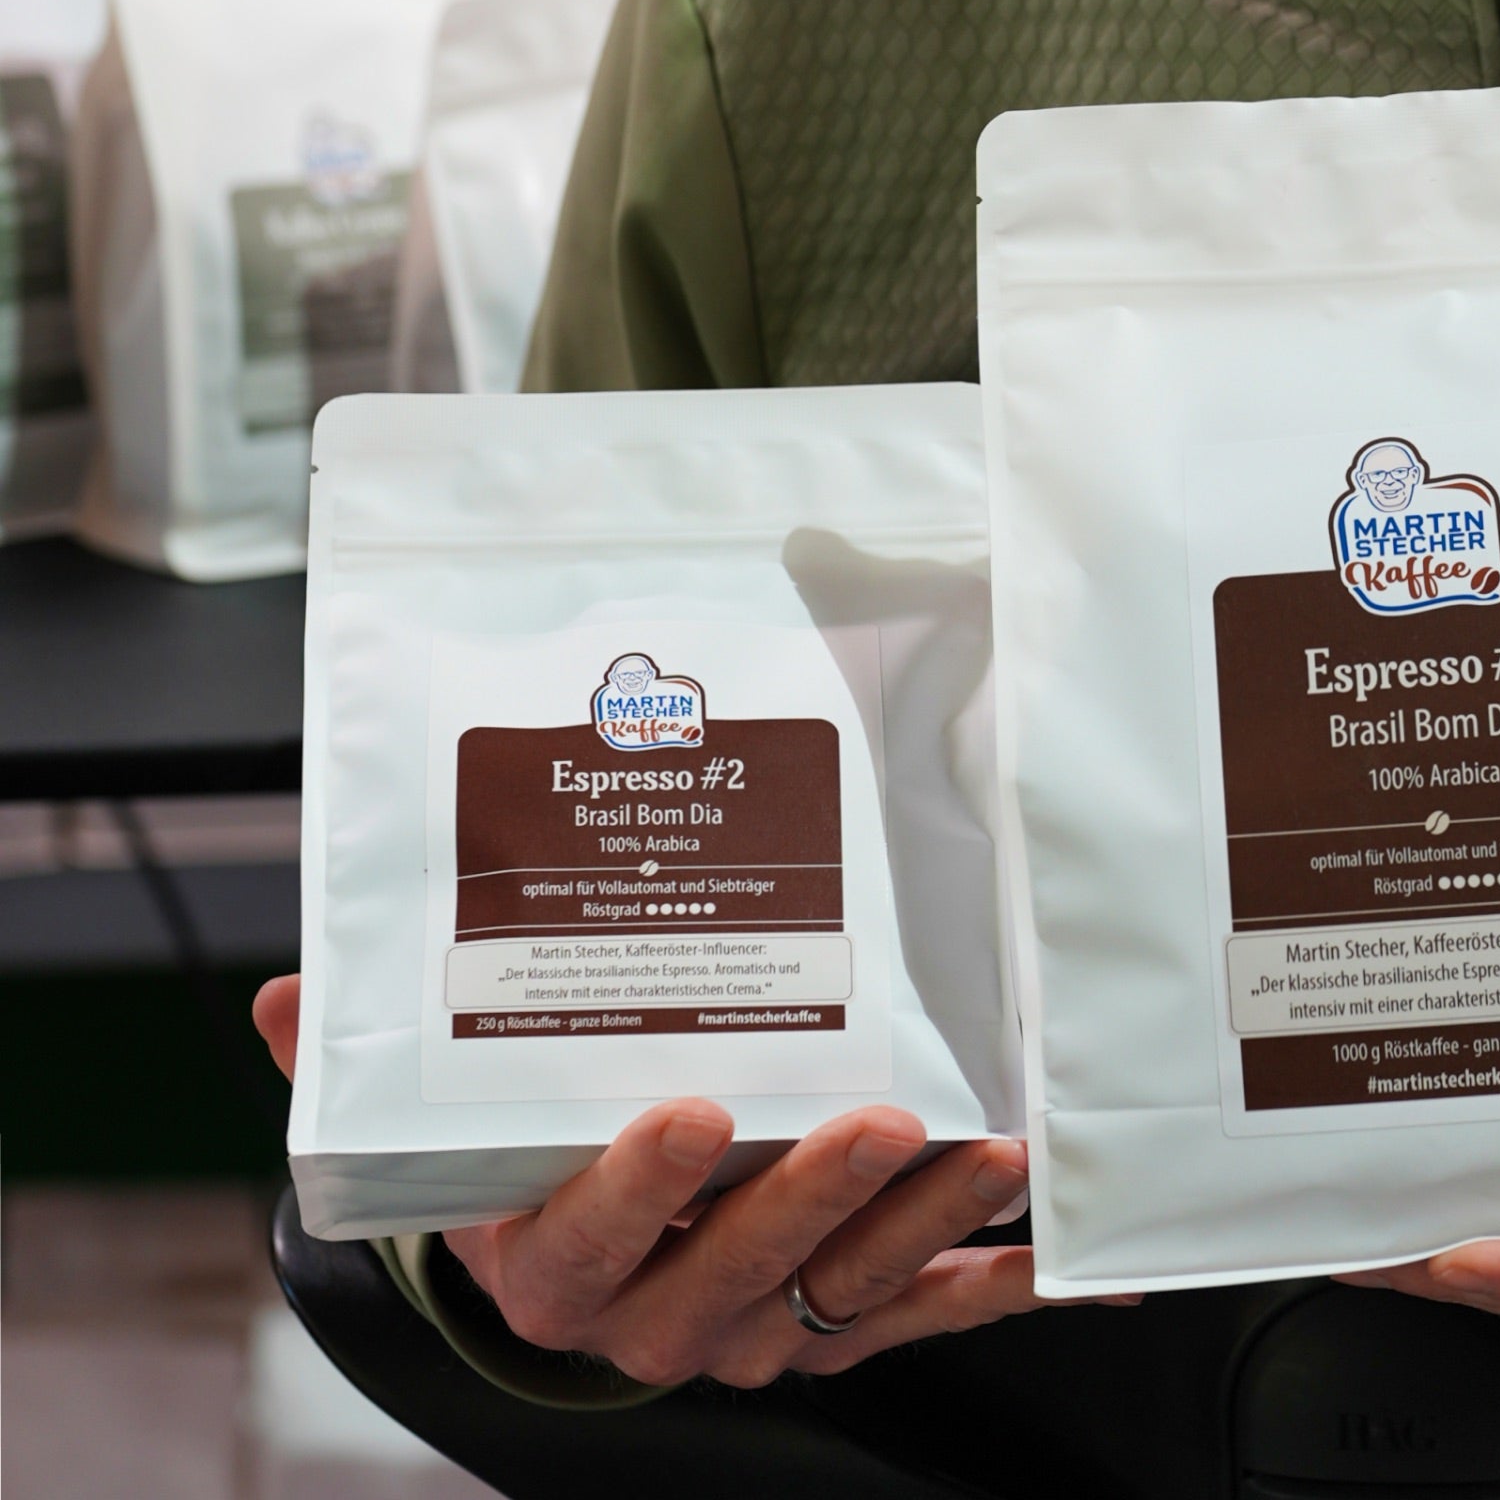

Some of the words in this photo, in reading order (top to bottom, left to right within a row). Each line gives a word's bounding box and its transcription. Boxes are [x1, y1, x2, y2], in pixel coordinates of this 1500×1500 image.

[1353, 510, 1484, 539] MARTIN
[1356, 531, 1485, 557] STECHER
[1345, 555, 1471, 599] Kaffee
[1305, 648, 1484, 702] Espresso
[607, 696, 692, 709] MARTIN
[607, 706, 692, 719] STECHER
[600, 719, 682, 742] Kaffee
[1330, 710, 1405, 747] Brasil
[1416, 706, 1478, 741] Bom
[551, 760, 693, 799] Espresso
[701, 757, 745, 790] #2
[1369, 766, 1424, 792] 100%
[1430, 762, 1500, 788] Arabica
[575, 804, 631, 826] Brasil
[638, 805, 684, 825] Bom
[690, 803, 723, 824] Dia
[598, 837, 641, 853] 100%
[645, 835, 700, 852] Arabica
[1310, 850, 1362, 872] optimal
[1365, 848, 1384, 867] für
[1387, 843, 1468, 865] Vollautomat
[1471, 841, 1497, 859] und
[522, 881, 573, 899] optimal
[576, 880, 595, 895] für
[597, 879, 676, 895] Vollautomat
[679, 879, 705, 894] und
[708, 878, 775, 896] Siebträger
[1373, 875, 1433, 897] Röstgrad
[583, 901, 641, 920] Röstgrad
[531, 946, 572, 959] Martin
[575, 945, 622, 959] Stecher,
[625, 943, 767, 957] Kaffeeröster-Influencer:
[1286, 944, 1340, 964] Martin
[1345, 937, 1409, 959] Stecher,
[528, 966, 582, 979] klassische
[585, 964, 660, 978] brasilianische
[662, 964, 711, 979] Espresso.
[714, 962, 776, 975] Aromatisch
[779, 962, 800, 975] und
[1251, 975, 1285, 996] „Der
[1288, 970, 1358, 991] klassische
[1363, 963, 1459, 986] brasilianische
[525, 987, 568, 1000] intensiv
[572, 986, 590, 999] mit
[592, 986, 621, 998] einer
[624, 983, 724, 997] charakteristischen
[698, 1011, 821, 1026] #martinstecherkaffee
[1290, 1000, 1345, 1019] intensiv
[1350, 998, 1374, 1015] mit
[1378, 996, 1413, 1013] einer
[476, 1018, 496, 1030] 250
[498, 1020, 505, 1033] g
[507, 1015, 560, 1030] Röstkaffee
[570, 1018, 600, 1032] ganze
[602, 1014, 642, 1027] Bohnen
[1332, 1043, 1368, 1064] 1000
[1371, 1047, 1381, 1065] g
[1384, 1037, 1459, 1059] Röstkaffee
